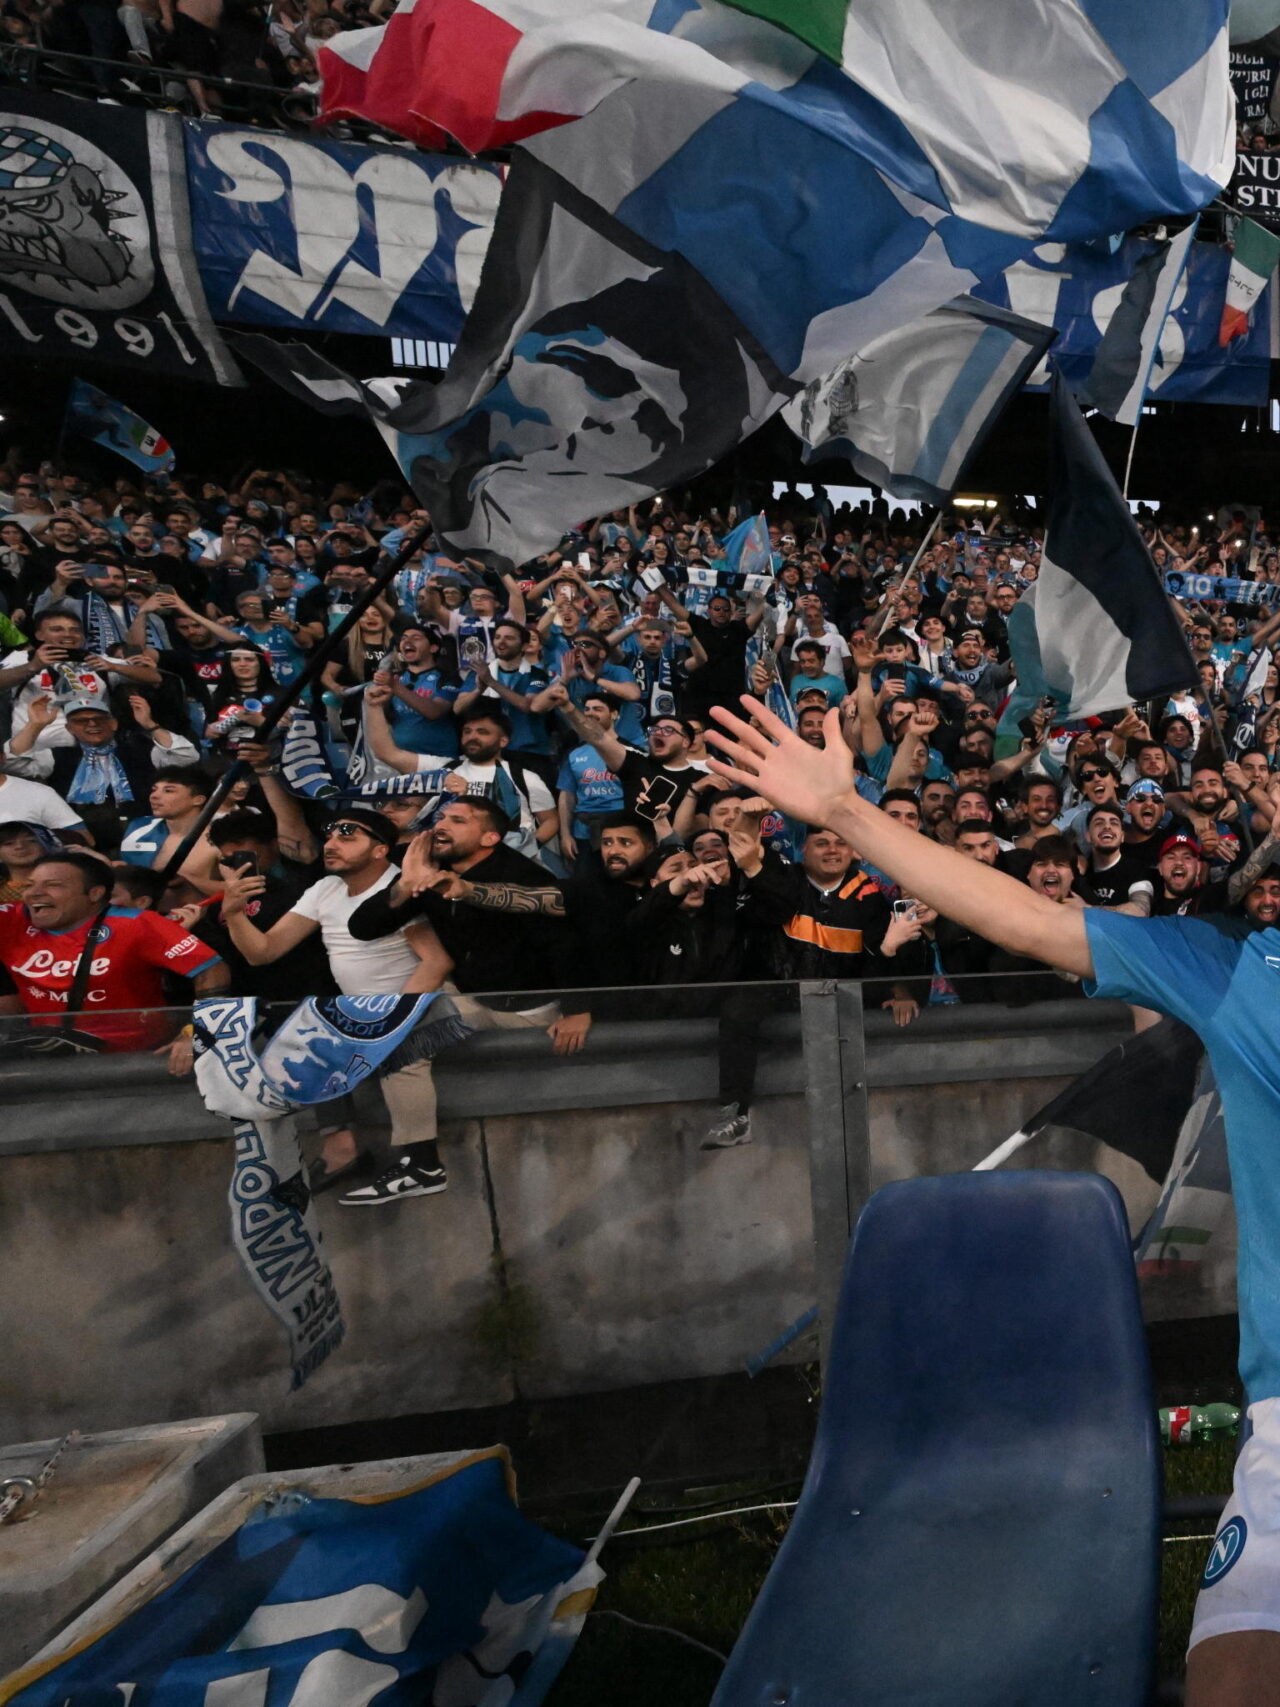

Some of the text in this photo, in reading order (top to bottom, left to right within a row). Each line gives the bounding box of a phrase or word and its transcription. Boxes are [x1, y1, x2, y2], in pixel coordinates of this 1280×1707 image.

[1186, 576, 1211, 595] 10
[362, 773, 445, 796] D'ITAL
[591, 786, 616, 795] MSC
[760, 815, 785, 837] Le
[164, 935, 199, 959] amaz
[49, 989, 107, 1003] MC
[233, 1117, 321, 1302] NAPOL
[1207, 1531, 1236, 1572] N
